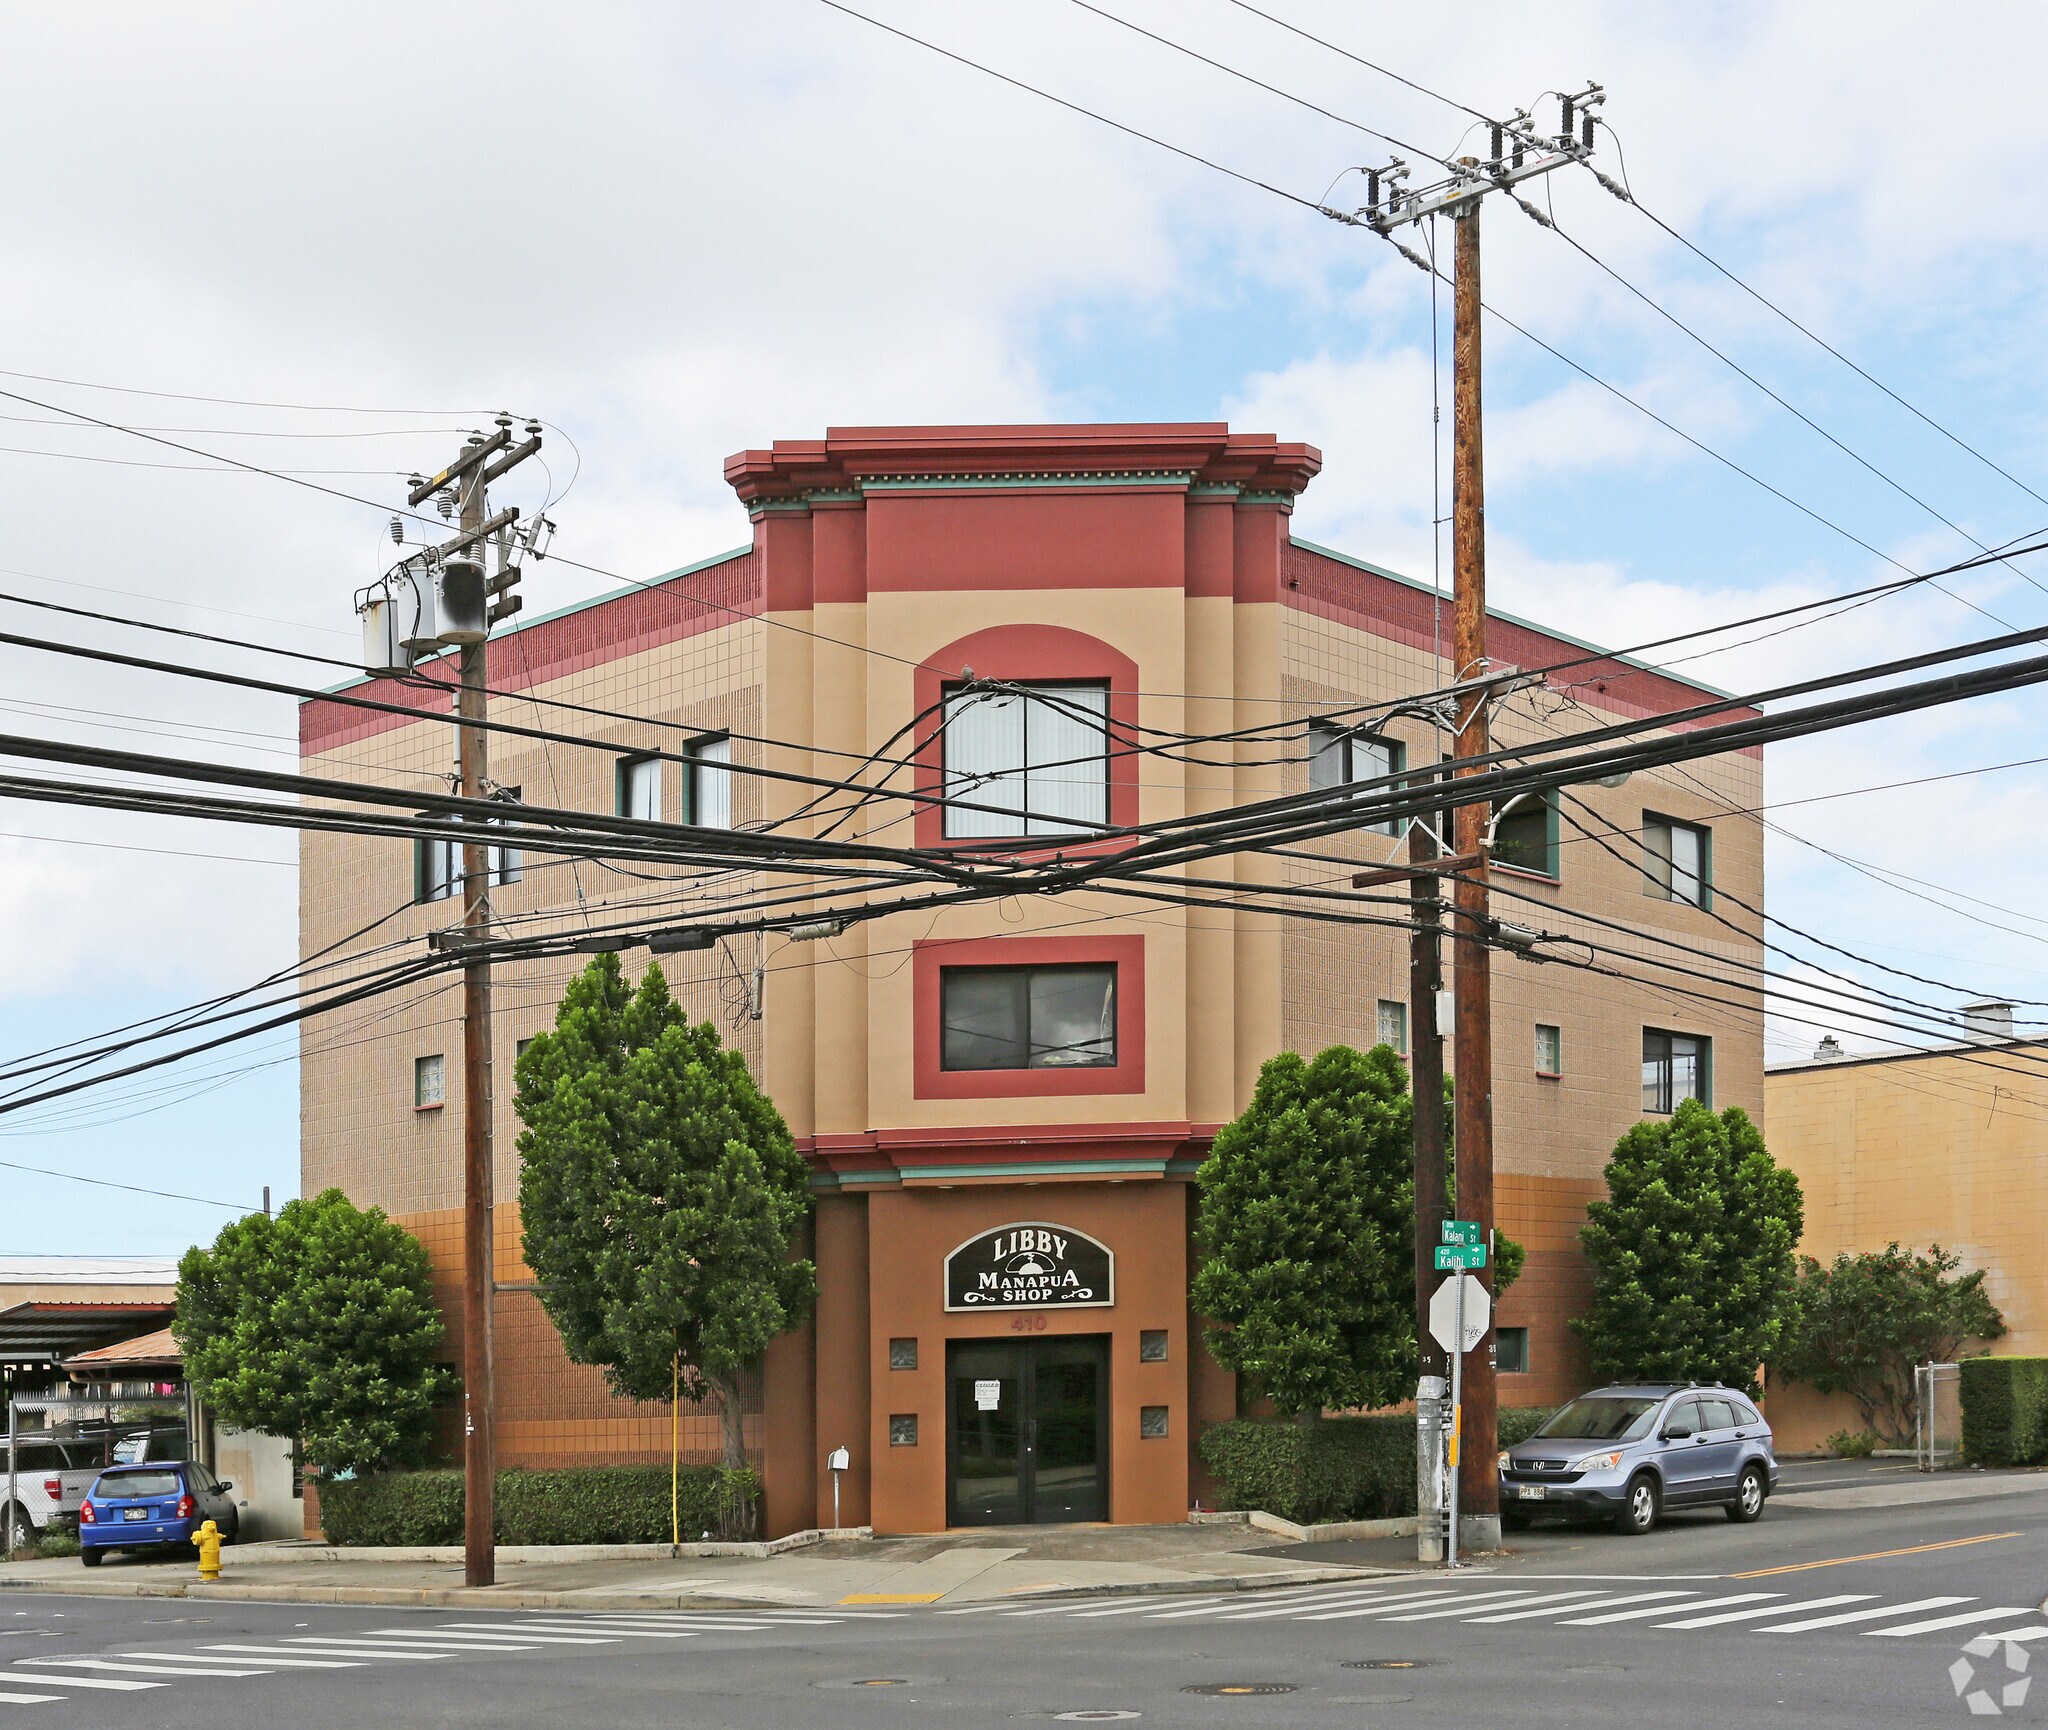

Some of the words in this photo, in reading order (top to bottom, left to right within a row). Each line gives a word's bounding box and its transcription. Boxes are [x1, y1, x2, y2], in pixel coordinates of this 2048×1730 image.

[993, 1229, 1068, 1262] LIBBY
[1470, 1234, 1476, 1243] St
[1440, 1254, 1464, 1267] Kalihi
[1471, 1256, 1479, 1266] St
[978, 1269, 1080, 1290] MANAPUA
[1002, 1288, 1053, 1302] SHOP
[1011, 1315, 1048, 1331] 410
